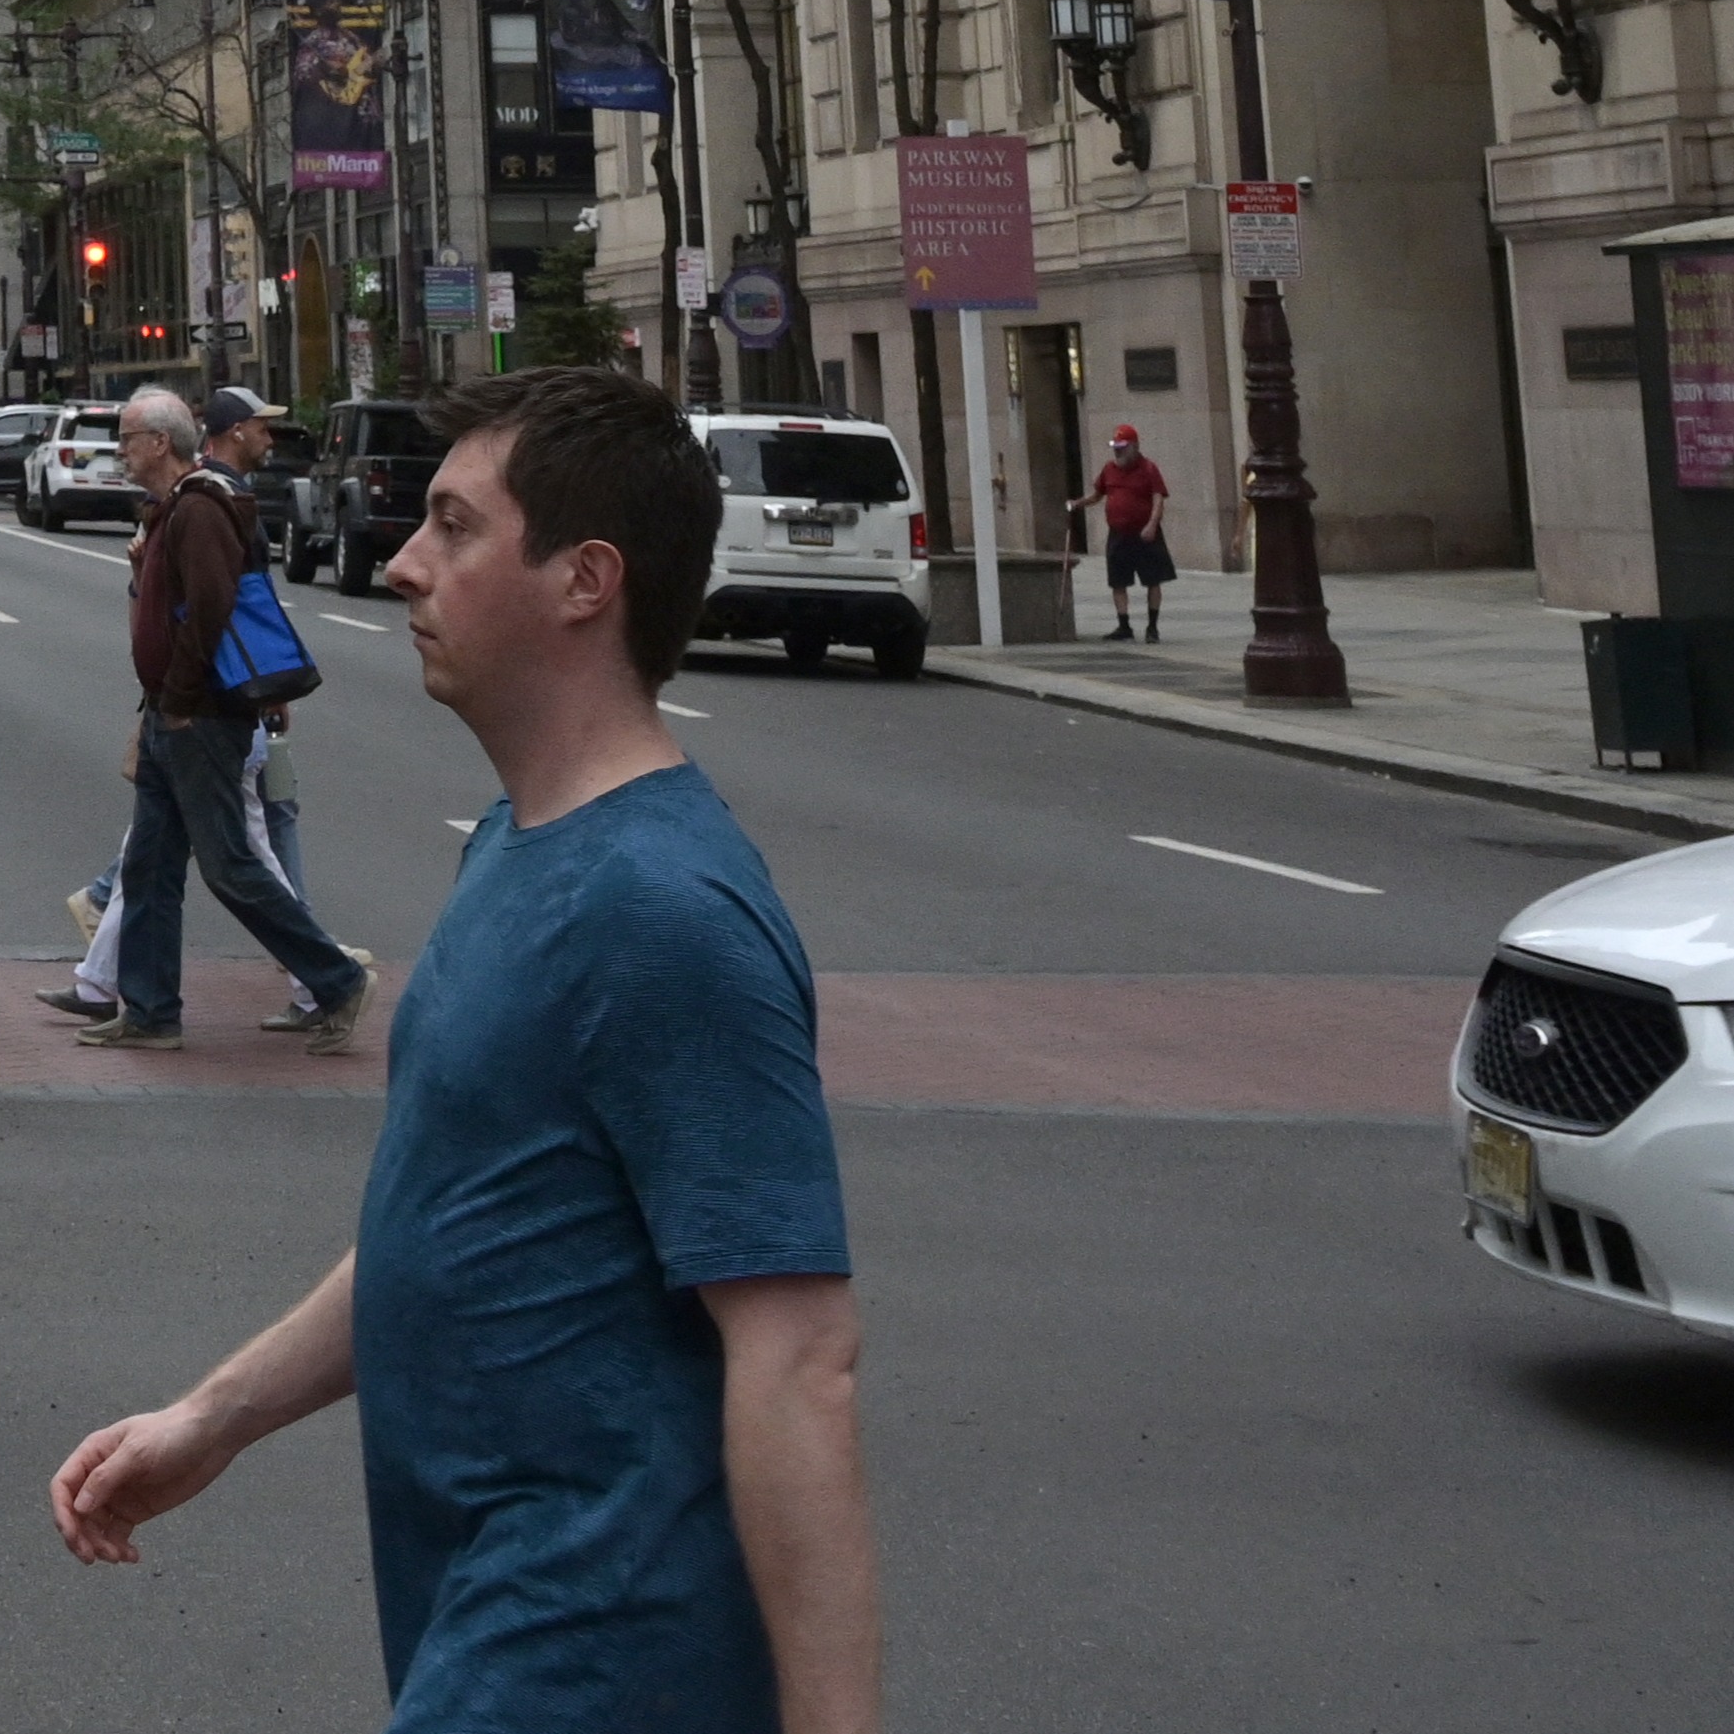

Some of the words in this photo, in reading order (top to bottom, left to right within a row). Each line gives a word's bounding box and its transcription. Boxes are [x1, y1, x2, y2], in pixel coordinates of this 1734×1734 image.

[297, 155, 380, 173] theMann
[907, 150, 1008, 167] PARKWAY
[908, 170, 1014, 187] MUSEUMS
[1229, 194, 1294, 204] EMERGENCY
[910, 202, 1025, 215] INDEPENDENCE
[1243, 204, 1280, 213] ROUTE
[910, 220, 1013, 236] HISTORIC
[913, 241, 970, 257] AREA
